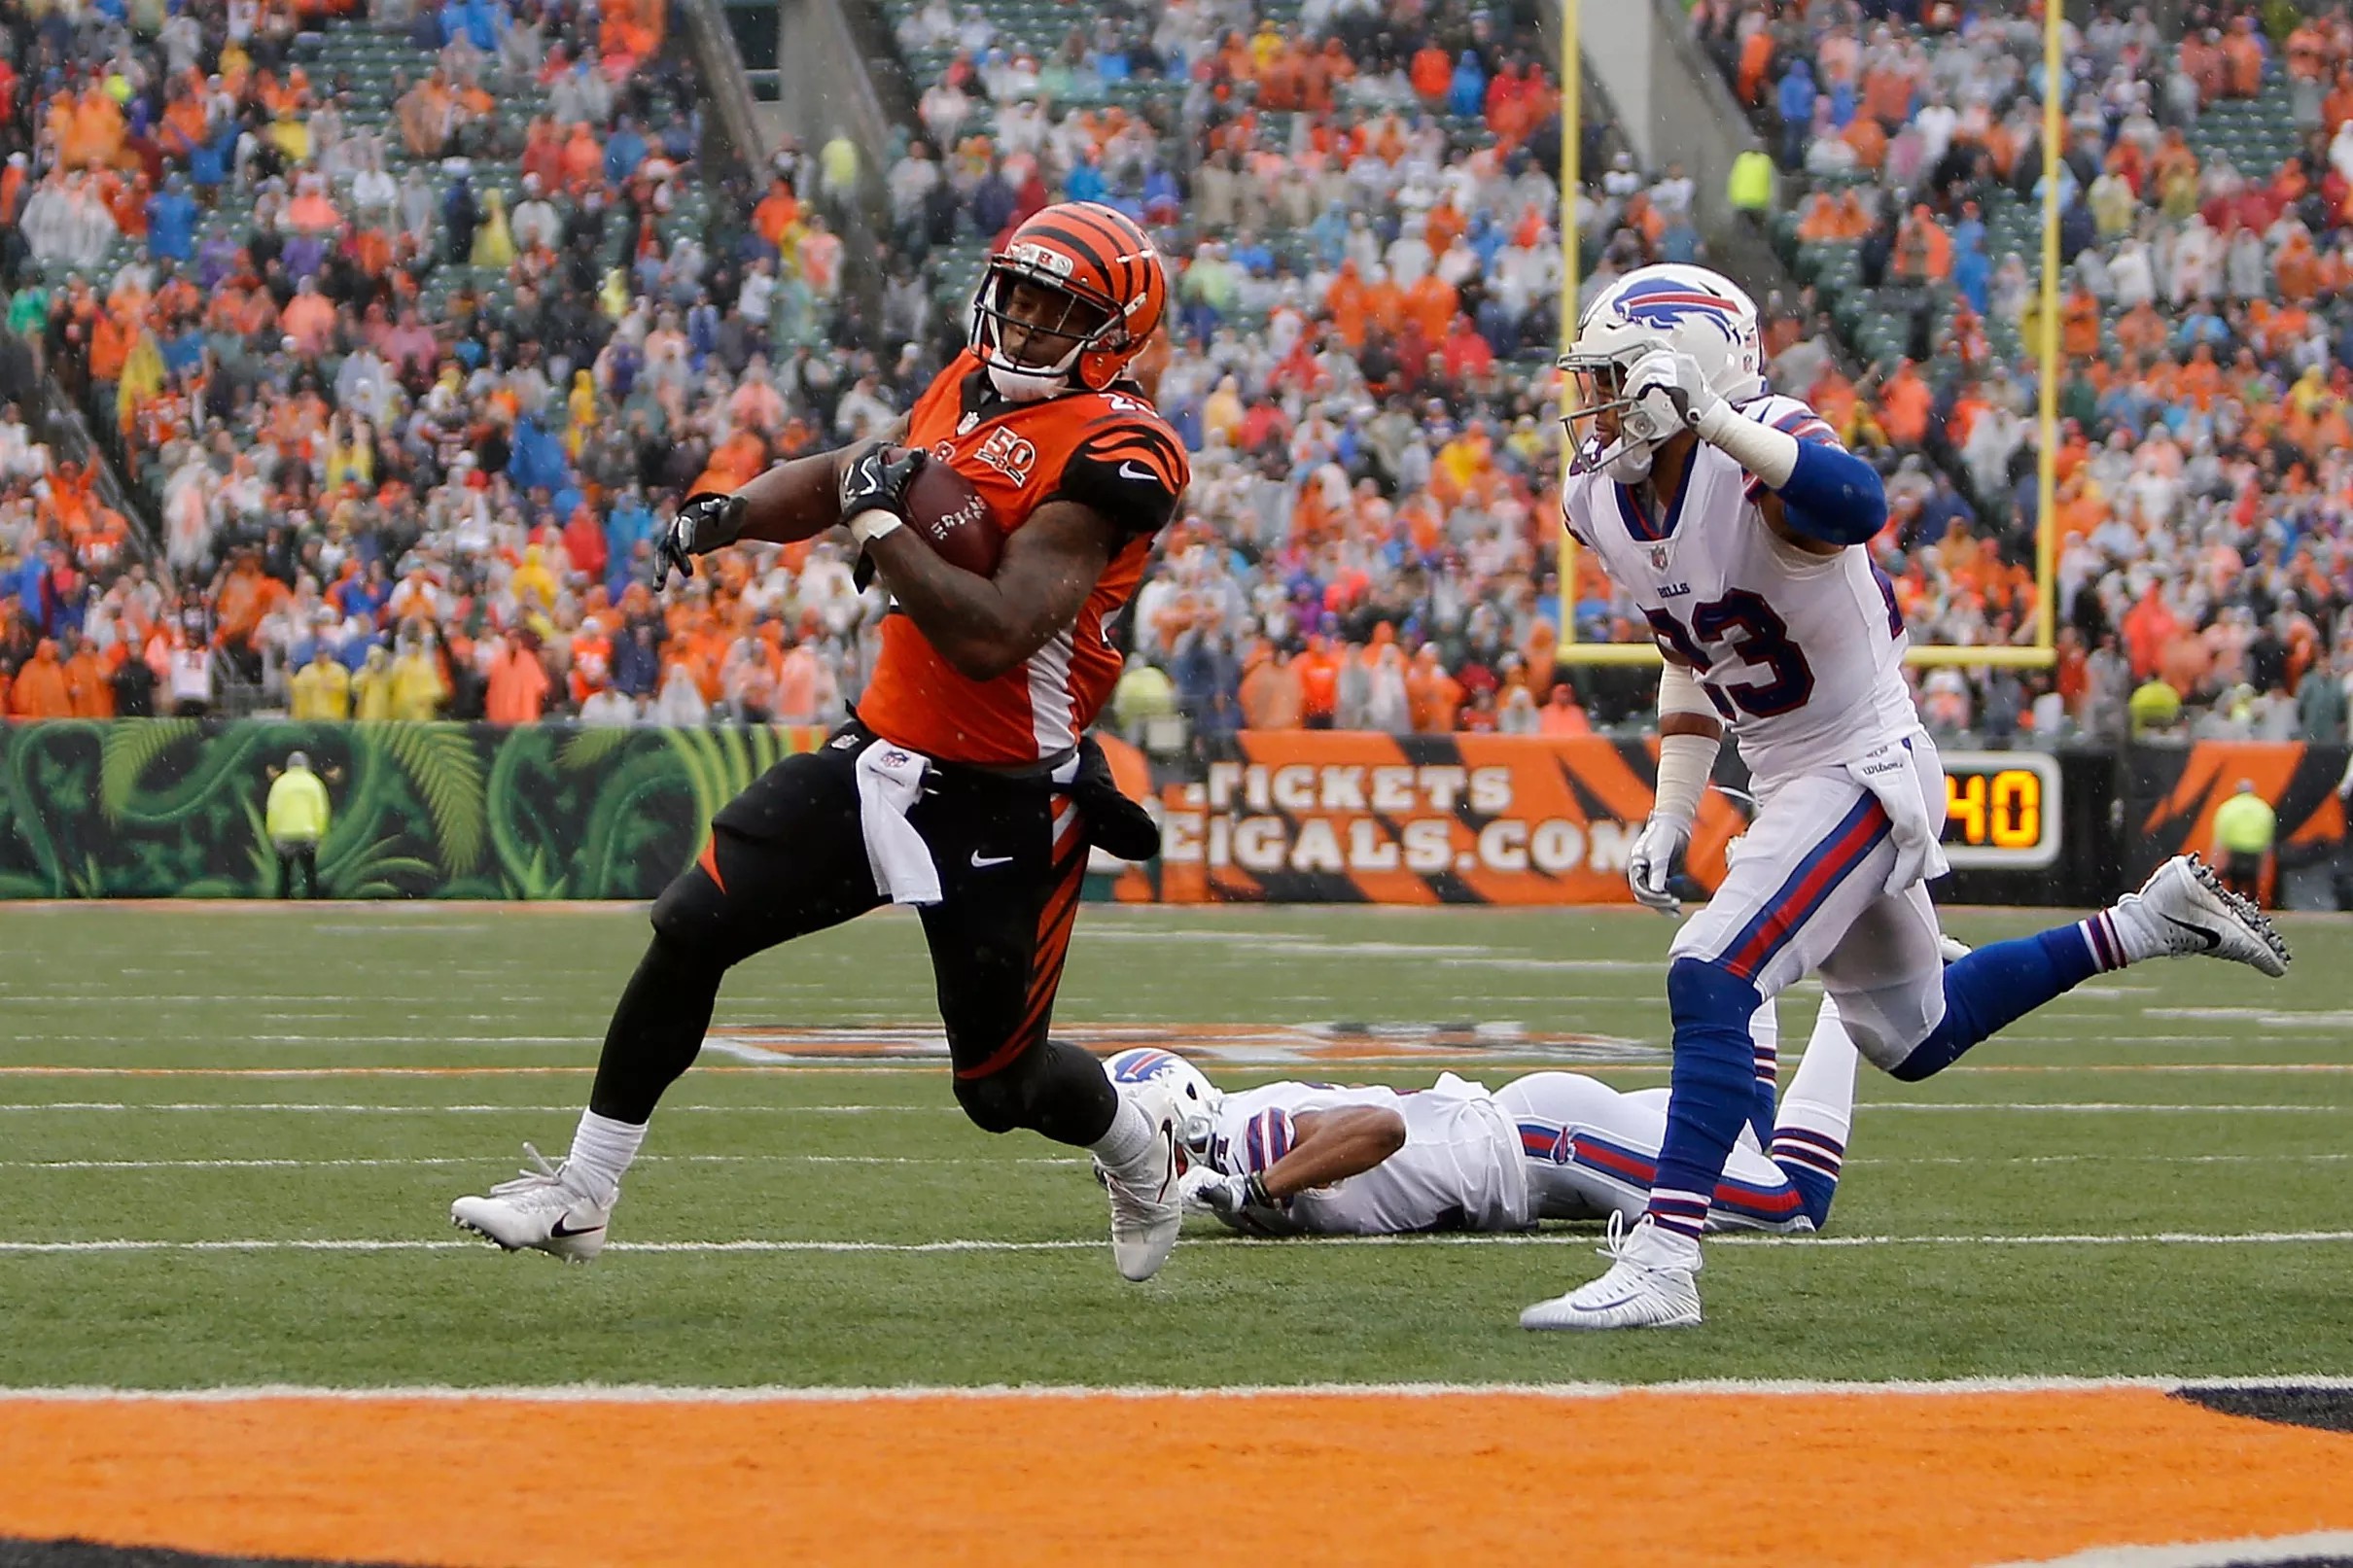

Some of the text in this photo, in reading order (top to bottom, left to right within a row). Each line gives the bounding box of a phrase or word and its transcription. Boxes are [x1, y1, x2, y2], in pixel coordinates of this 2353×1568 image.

[1657, 582, 1691, 599] BILLS
[1862, 761, 1902, 776] Wilson
[1184, 760, 1513, 816] TICKETS
[1945, 769, 2041, 849] 40
